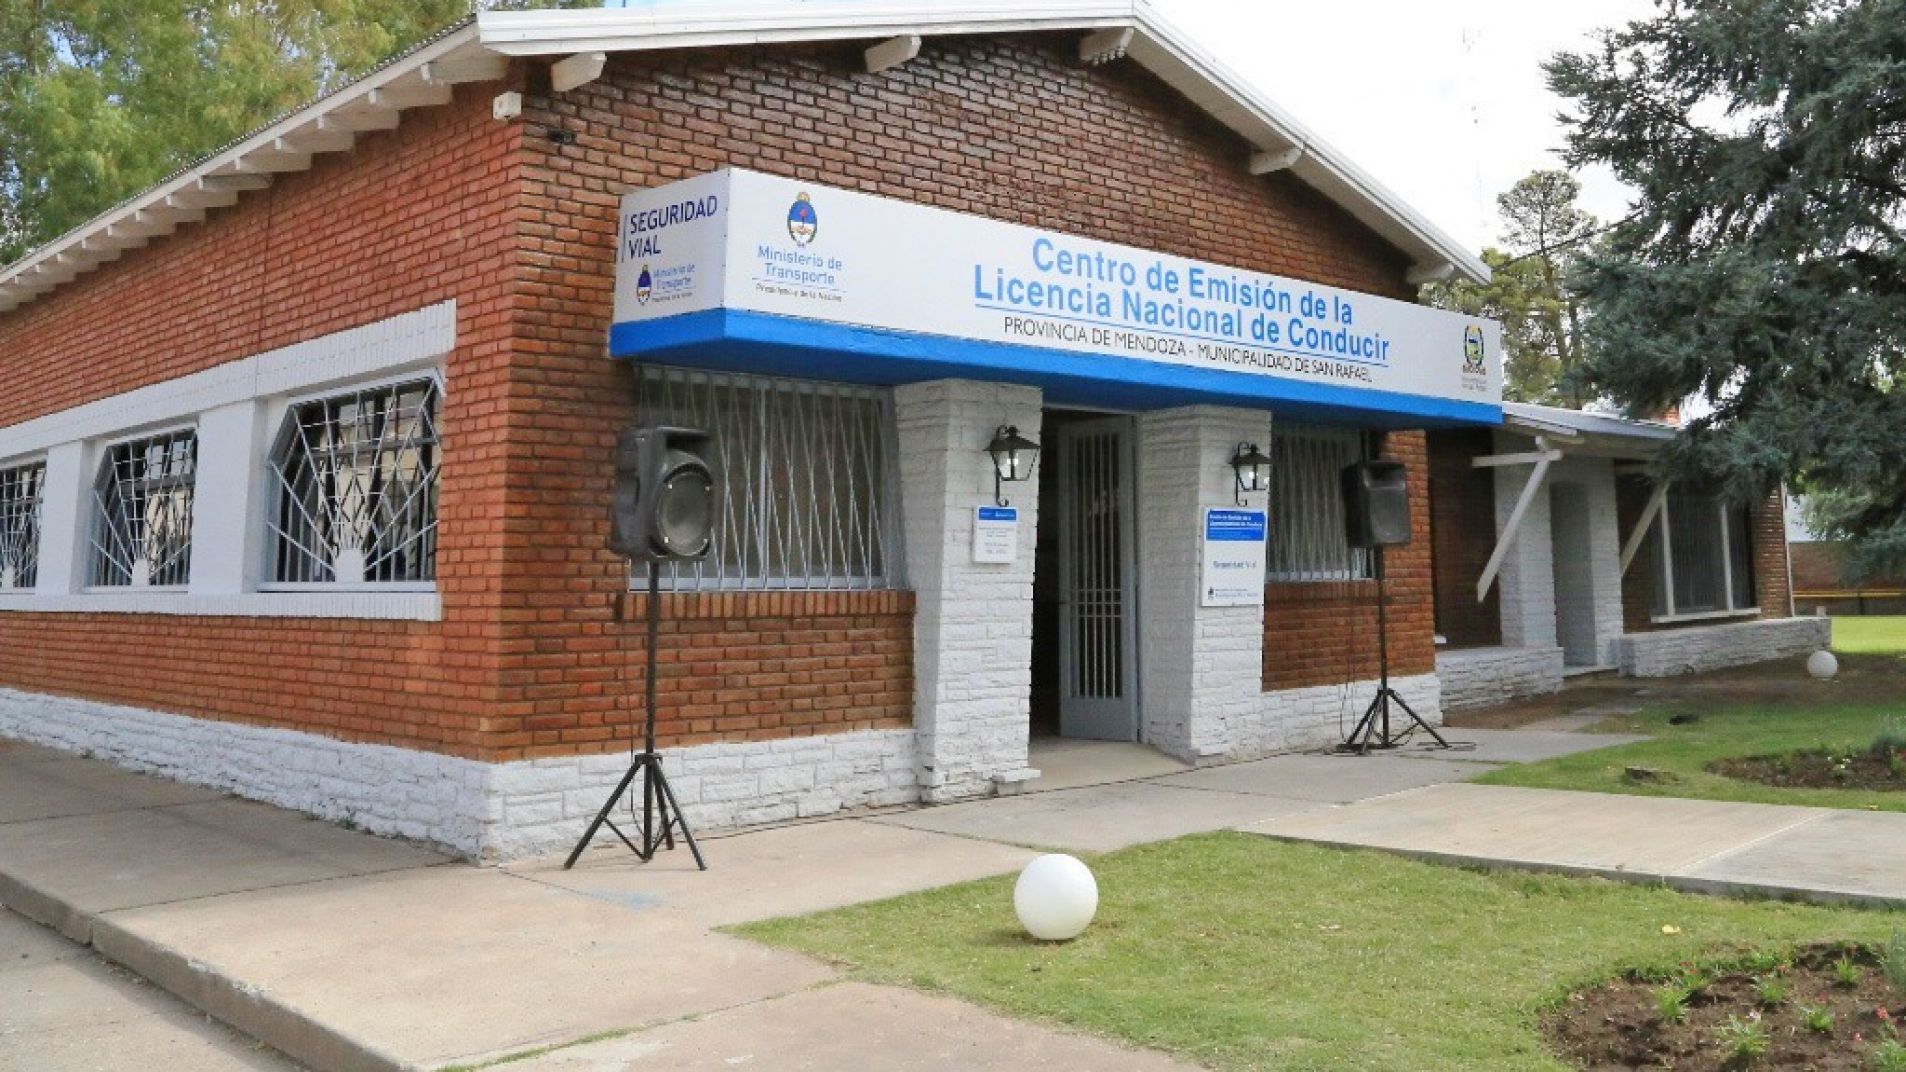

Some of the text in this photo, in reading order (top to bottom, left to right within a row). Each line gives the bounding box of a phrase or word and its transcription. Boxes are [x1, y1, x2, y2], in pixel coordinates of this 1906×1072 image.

[630, 195, 718, 235] SEGURIDAD
[628, 234, 662, 259] VIAL
[757, 245, 842, 270] Ministerio de
[765, 262, 835, 284] Transporte
[1032, 238, 1352, 325] Centro de Emisión de la
[975, 264, 1389, 360] Licencia Nacional de Conducir
[1004, 316, 1088, 343] PROVINCIA
[1092, 328, 1110, 346] DE
[1114, 331, 1187, 357] MENDOZA
[1198, 344, 1291, 371] MUNICIPALIDAD
[1295, 357, 1310, 373] DE
[1311, 359, 1334, 376] SAN
[1336, 364, 1373, 383] RAFAEL
